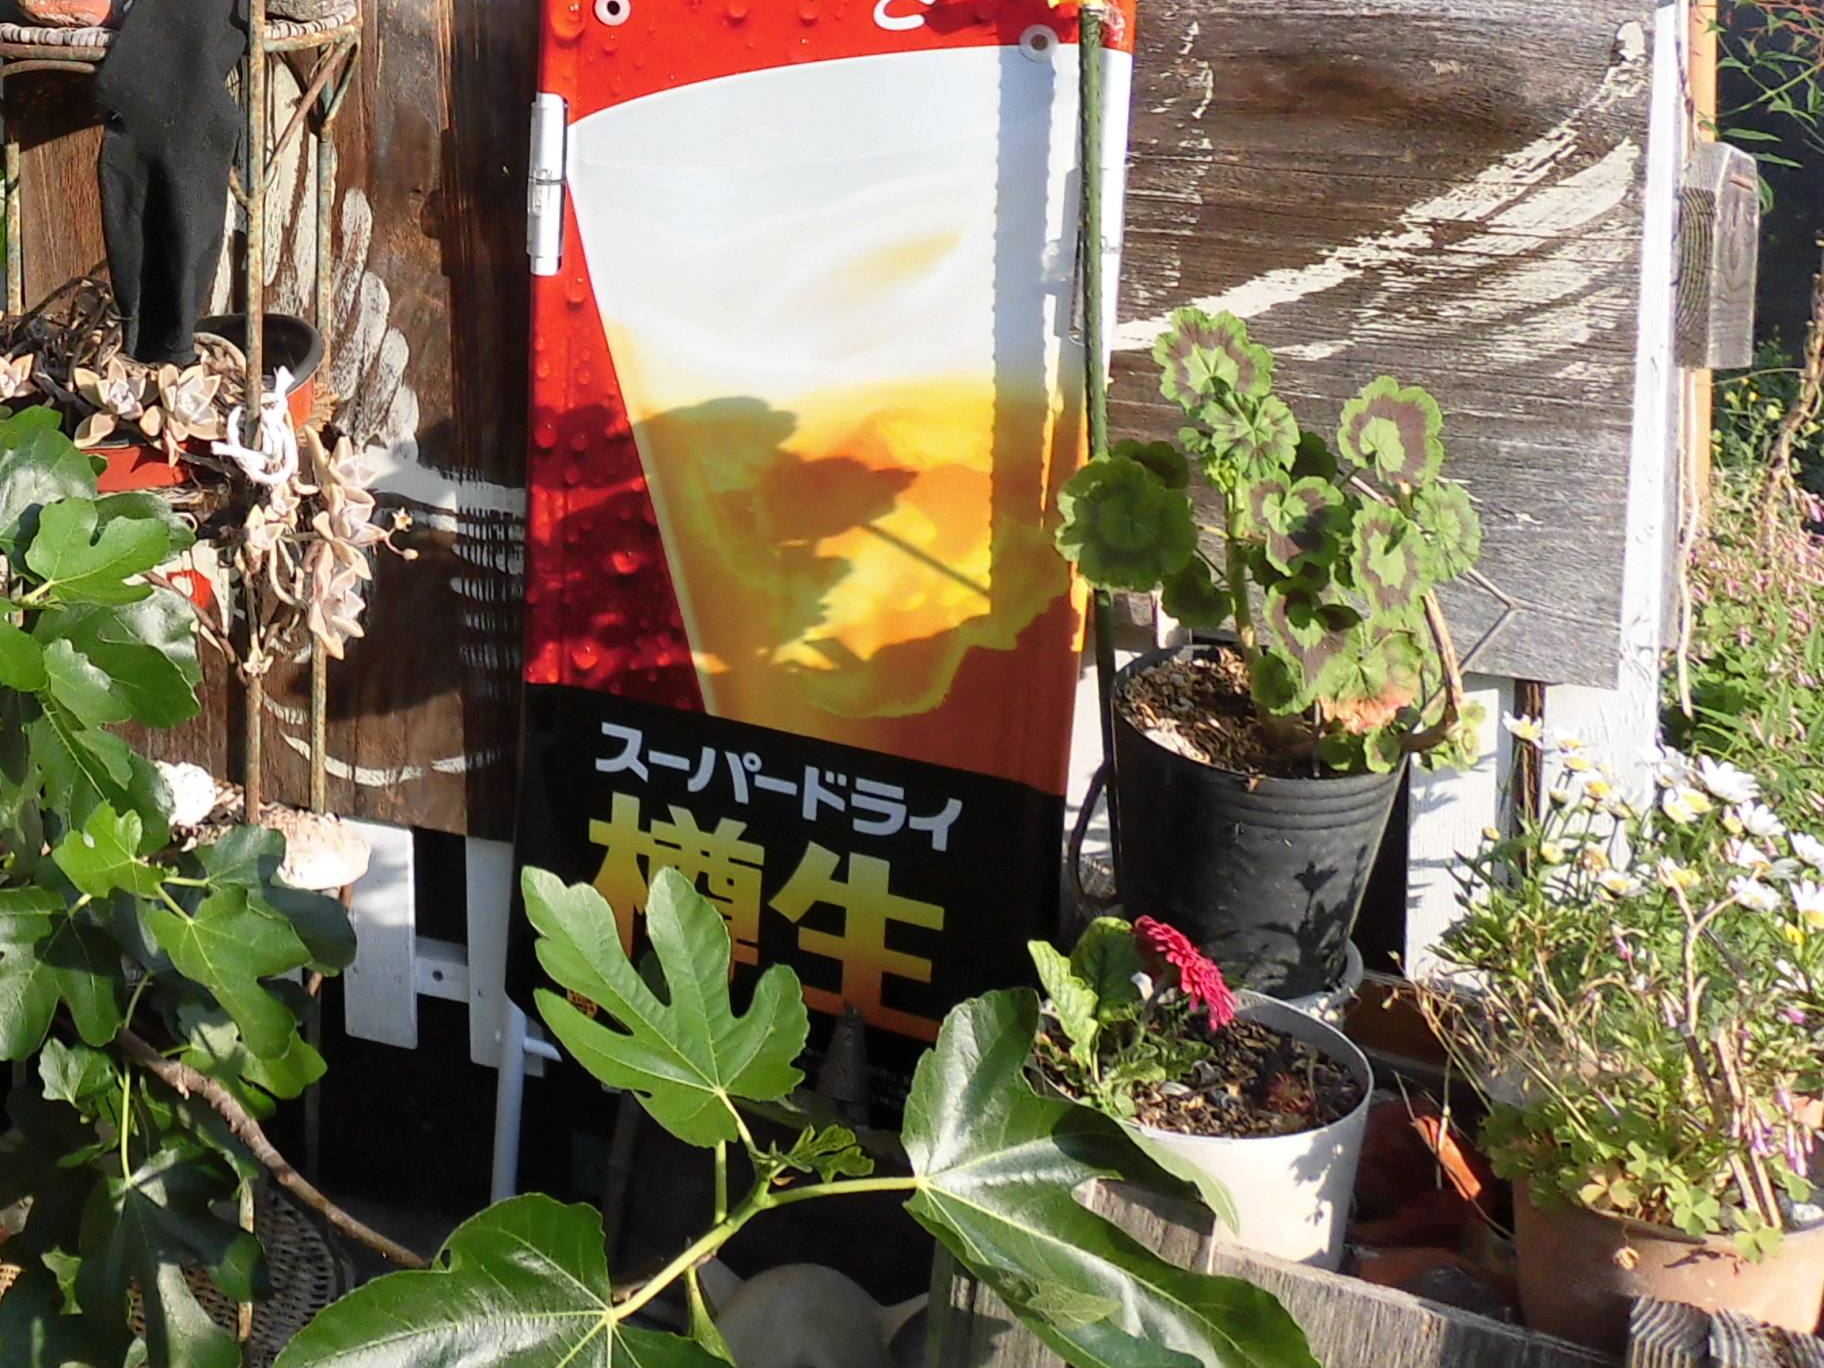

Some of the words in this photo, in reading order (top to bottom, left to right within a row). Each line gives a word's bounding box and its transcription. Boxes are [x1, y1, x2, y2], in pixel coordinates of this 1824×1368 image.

[595, 721, 963, 853] スーパードライ
